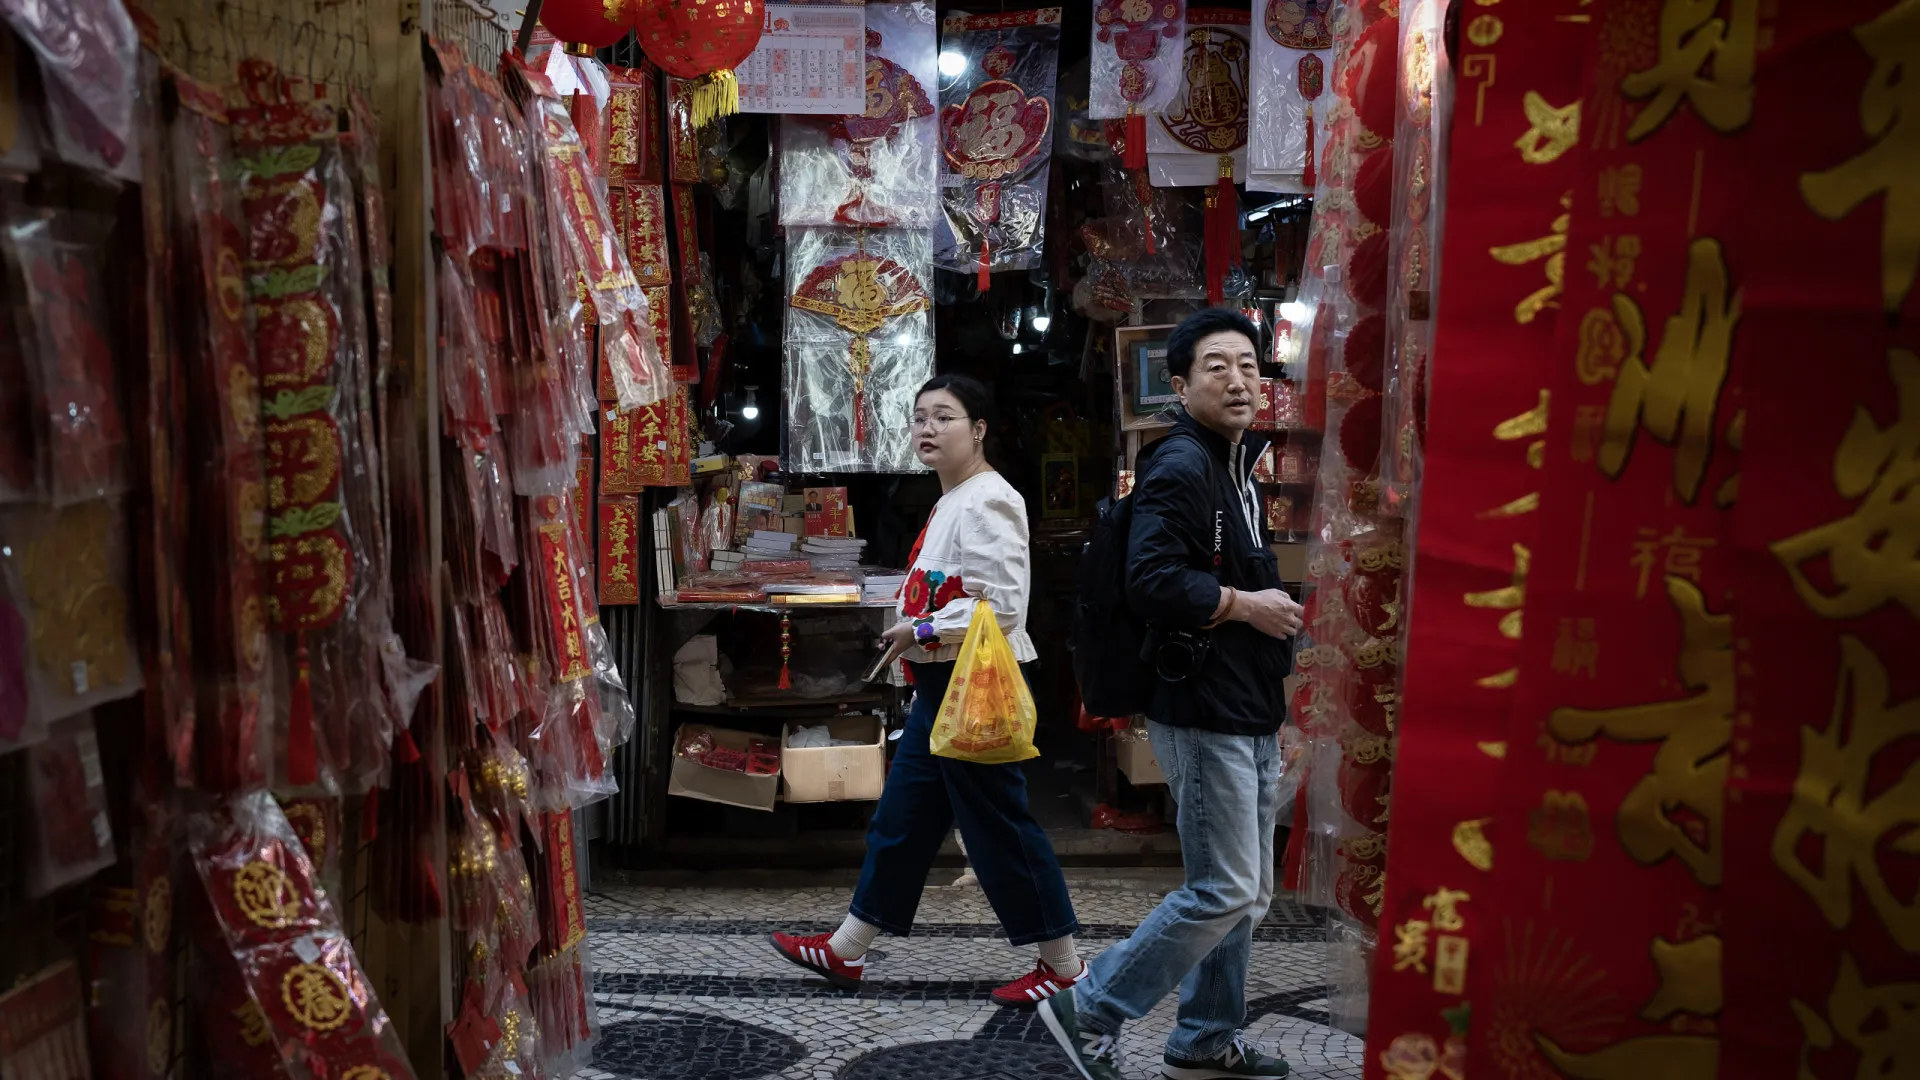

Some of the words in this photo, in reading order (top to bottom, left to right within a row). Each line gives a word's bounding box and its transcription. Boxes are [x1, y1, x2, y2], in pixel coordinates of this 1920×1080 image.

[960, 90, 1026, 162] 福
[835, 260, 887, 311] 福
[639, 401, 661, 462] 入平安
[608, 507, 631, 582] 上落平安
[1214, 510, 1223, 552] LUMIX
[553, 547, 581, 658] 大吉大利
